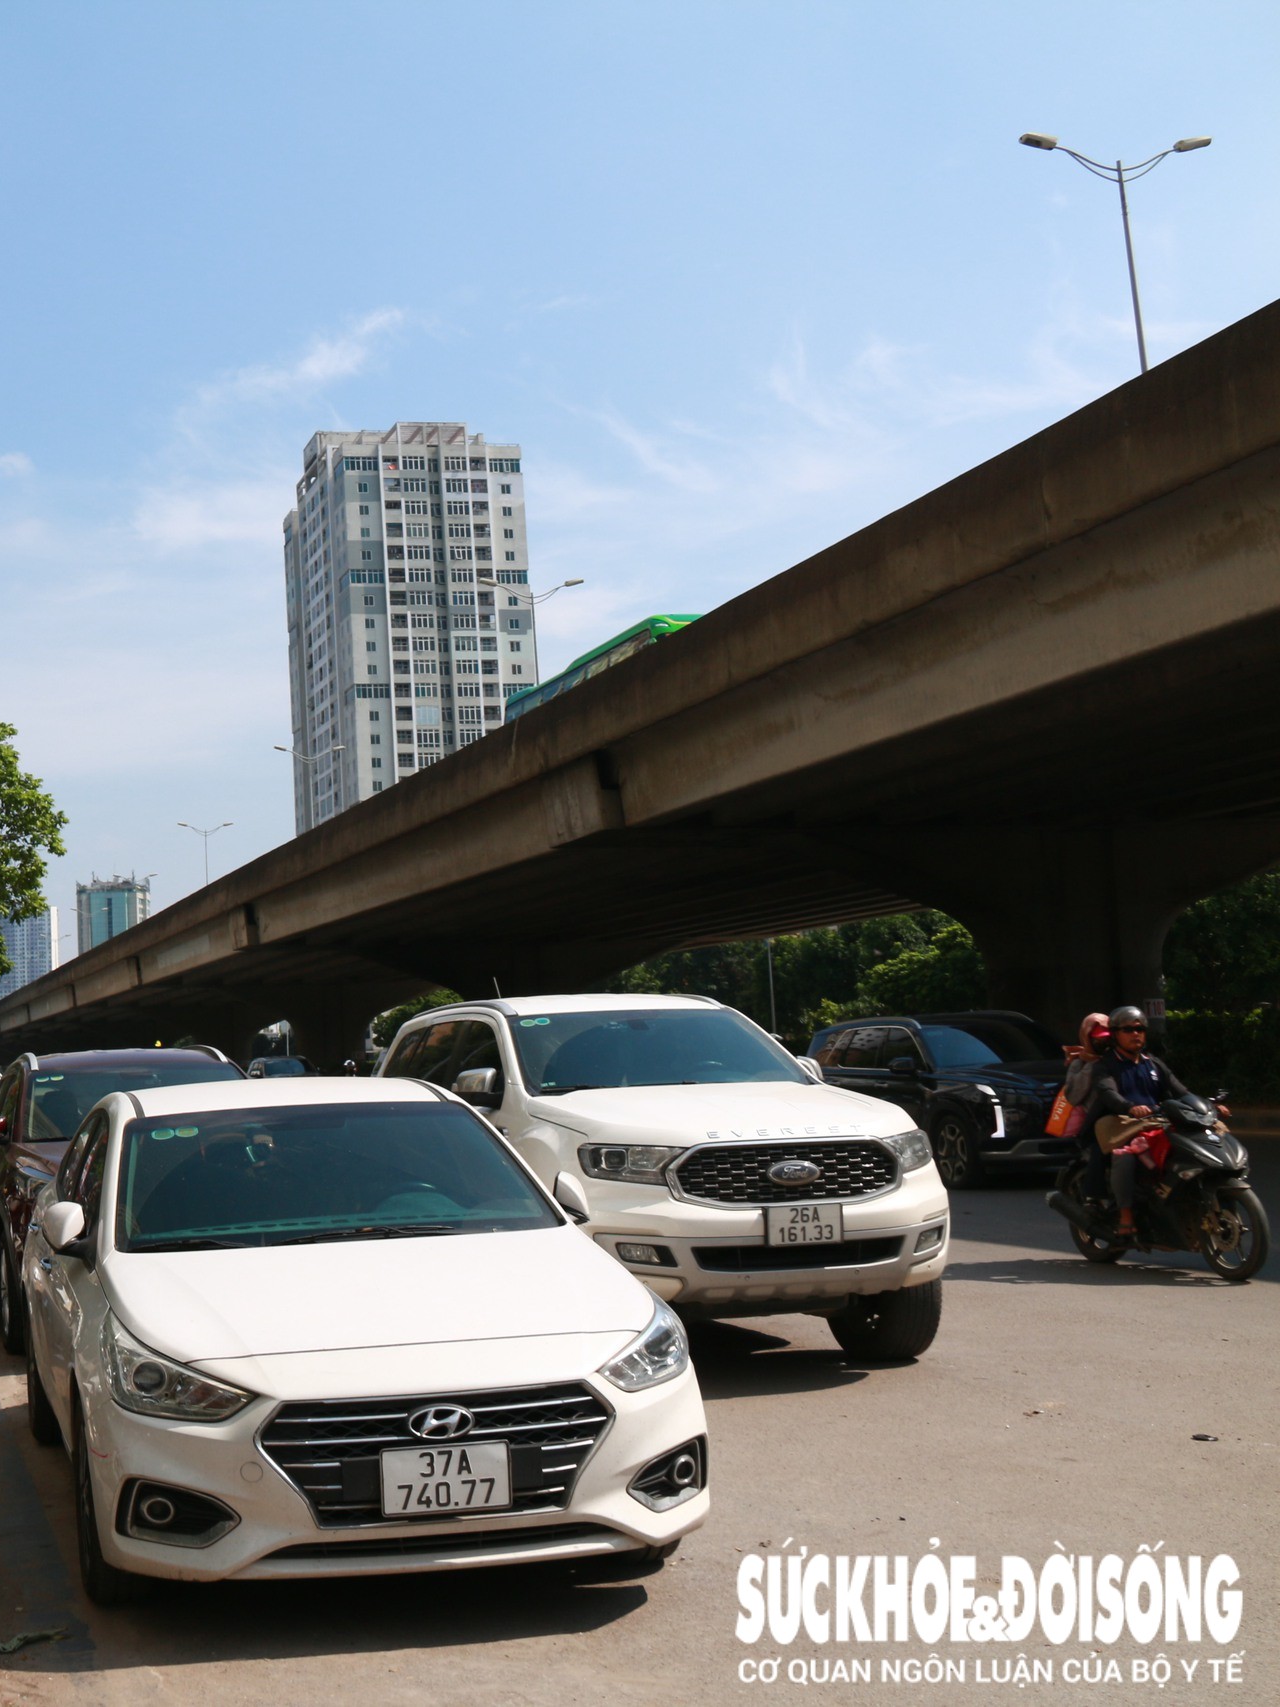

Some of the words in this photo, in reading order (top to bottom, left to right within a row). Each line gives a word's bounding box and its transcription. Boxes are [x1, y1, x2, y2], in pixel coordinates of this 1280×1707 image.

[706, 1124, 861, 1139] EVEREST
[782, 1165, 809, 1179] Ford
[790, 1206, 820, 1224] 26A
[779, 1224, 833, 1243] 161.33
[419, 1449, 472, 1478] 37A
[397, 1477, 495, 1510] 740.77
